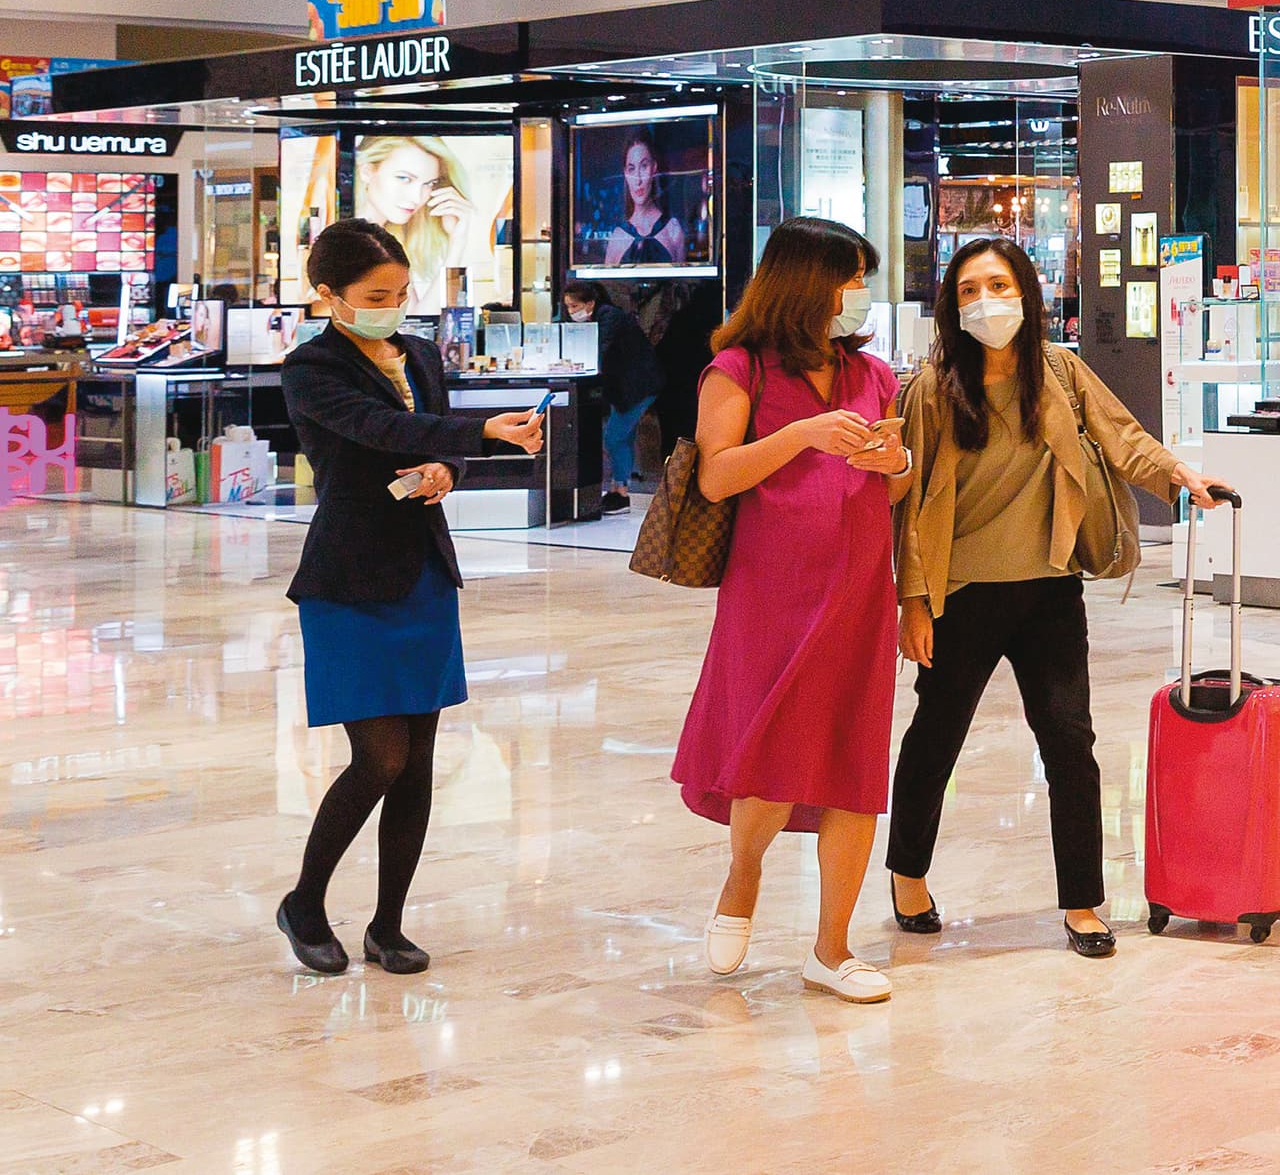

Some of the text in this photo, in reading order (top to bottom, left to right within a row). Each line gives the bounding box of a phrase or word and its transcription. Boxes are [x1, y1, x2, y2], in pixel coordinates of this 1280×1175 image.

[360, 36, 451, 81] LAUDER
[16, 132, 167, 154] shu uemura
